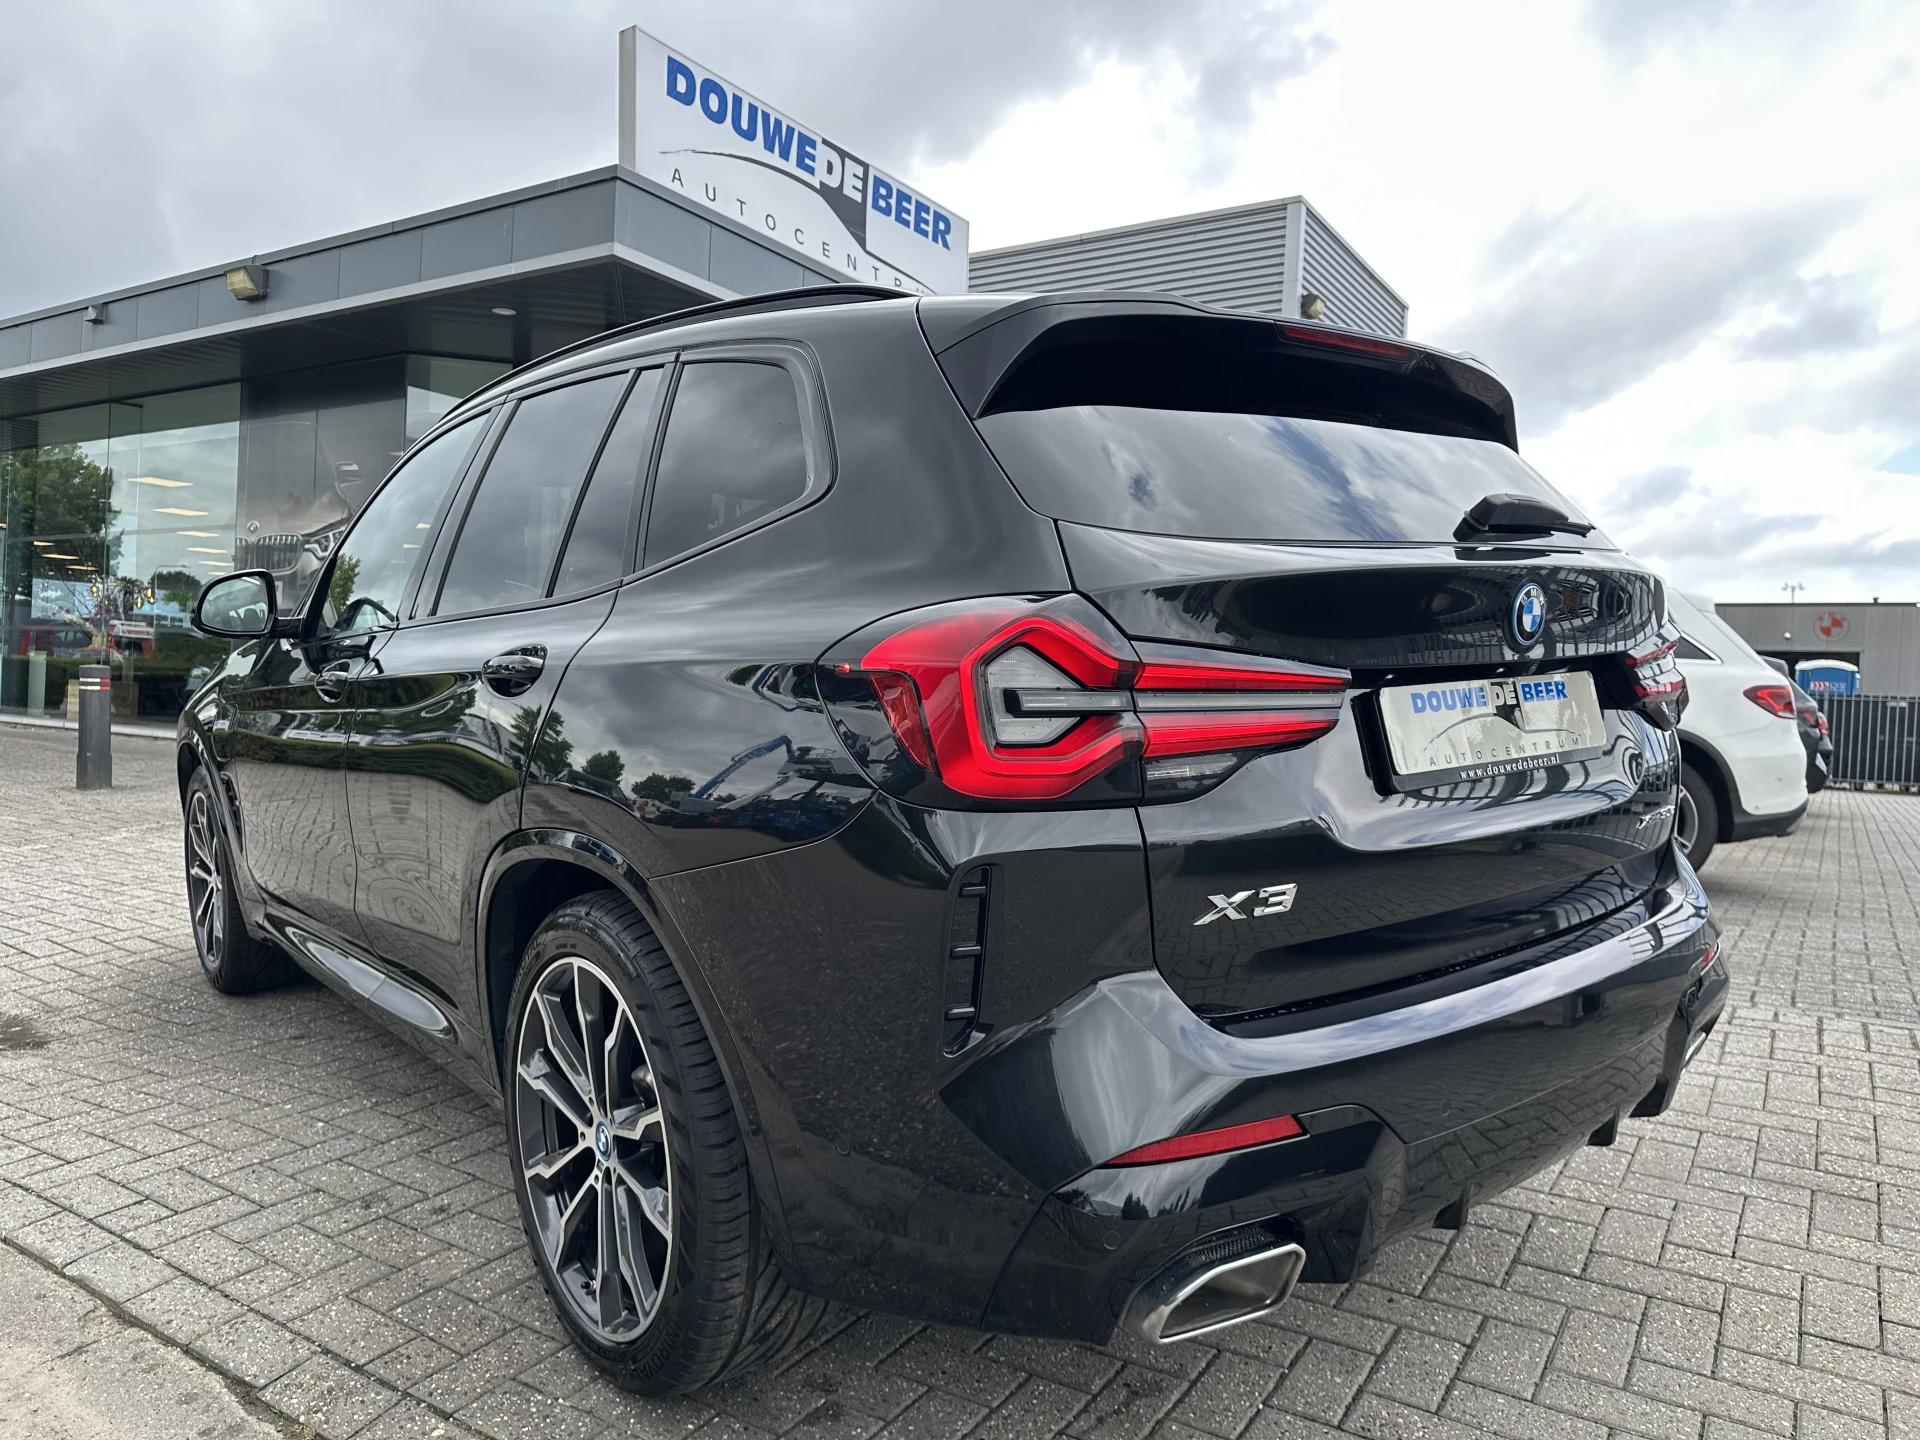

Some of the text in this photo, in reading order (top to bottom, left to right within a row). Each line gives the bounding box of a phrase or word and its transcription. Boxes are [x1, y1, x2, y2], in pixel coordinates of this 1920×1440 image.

[666, 55, 951, 251] DOUWE DE BEER
[671, 167, 925, 294] AUTOCENTR
[1411, 680, 1568, 713] DOUWE DE BEER
[1429, 737, 1580, 767] AUTOCENTRUM
[1460, 753, 1559, 780] www.douwedebeer.nl
[1192, 883, 1298, 926] X3
